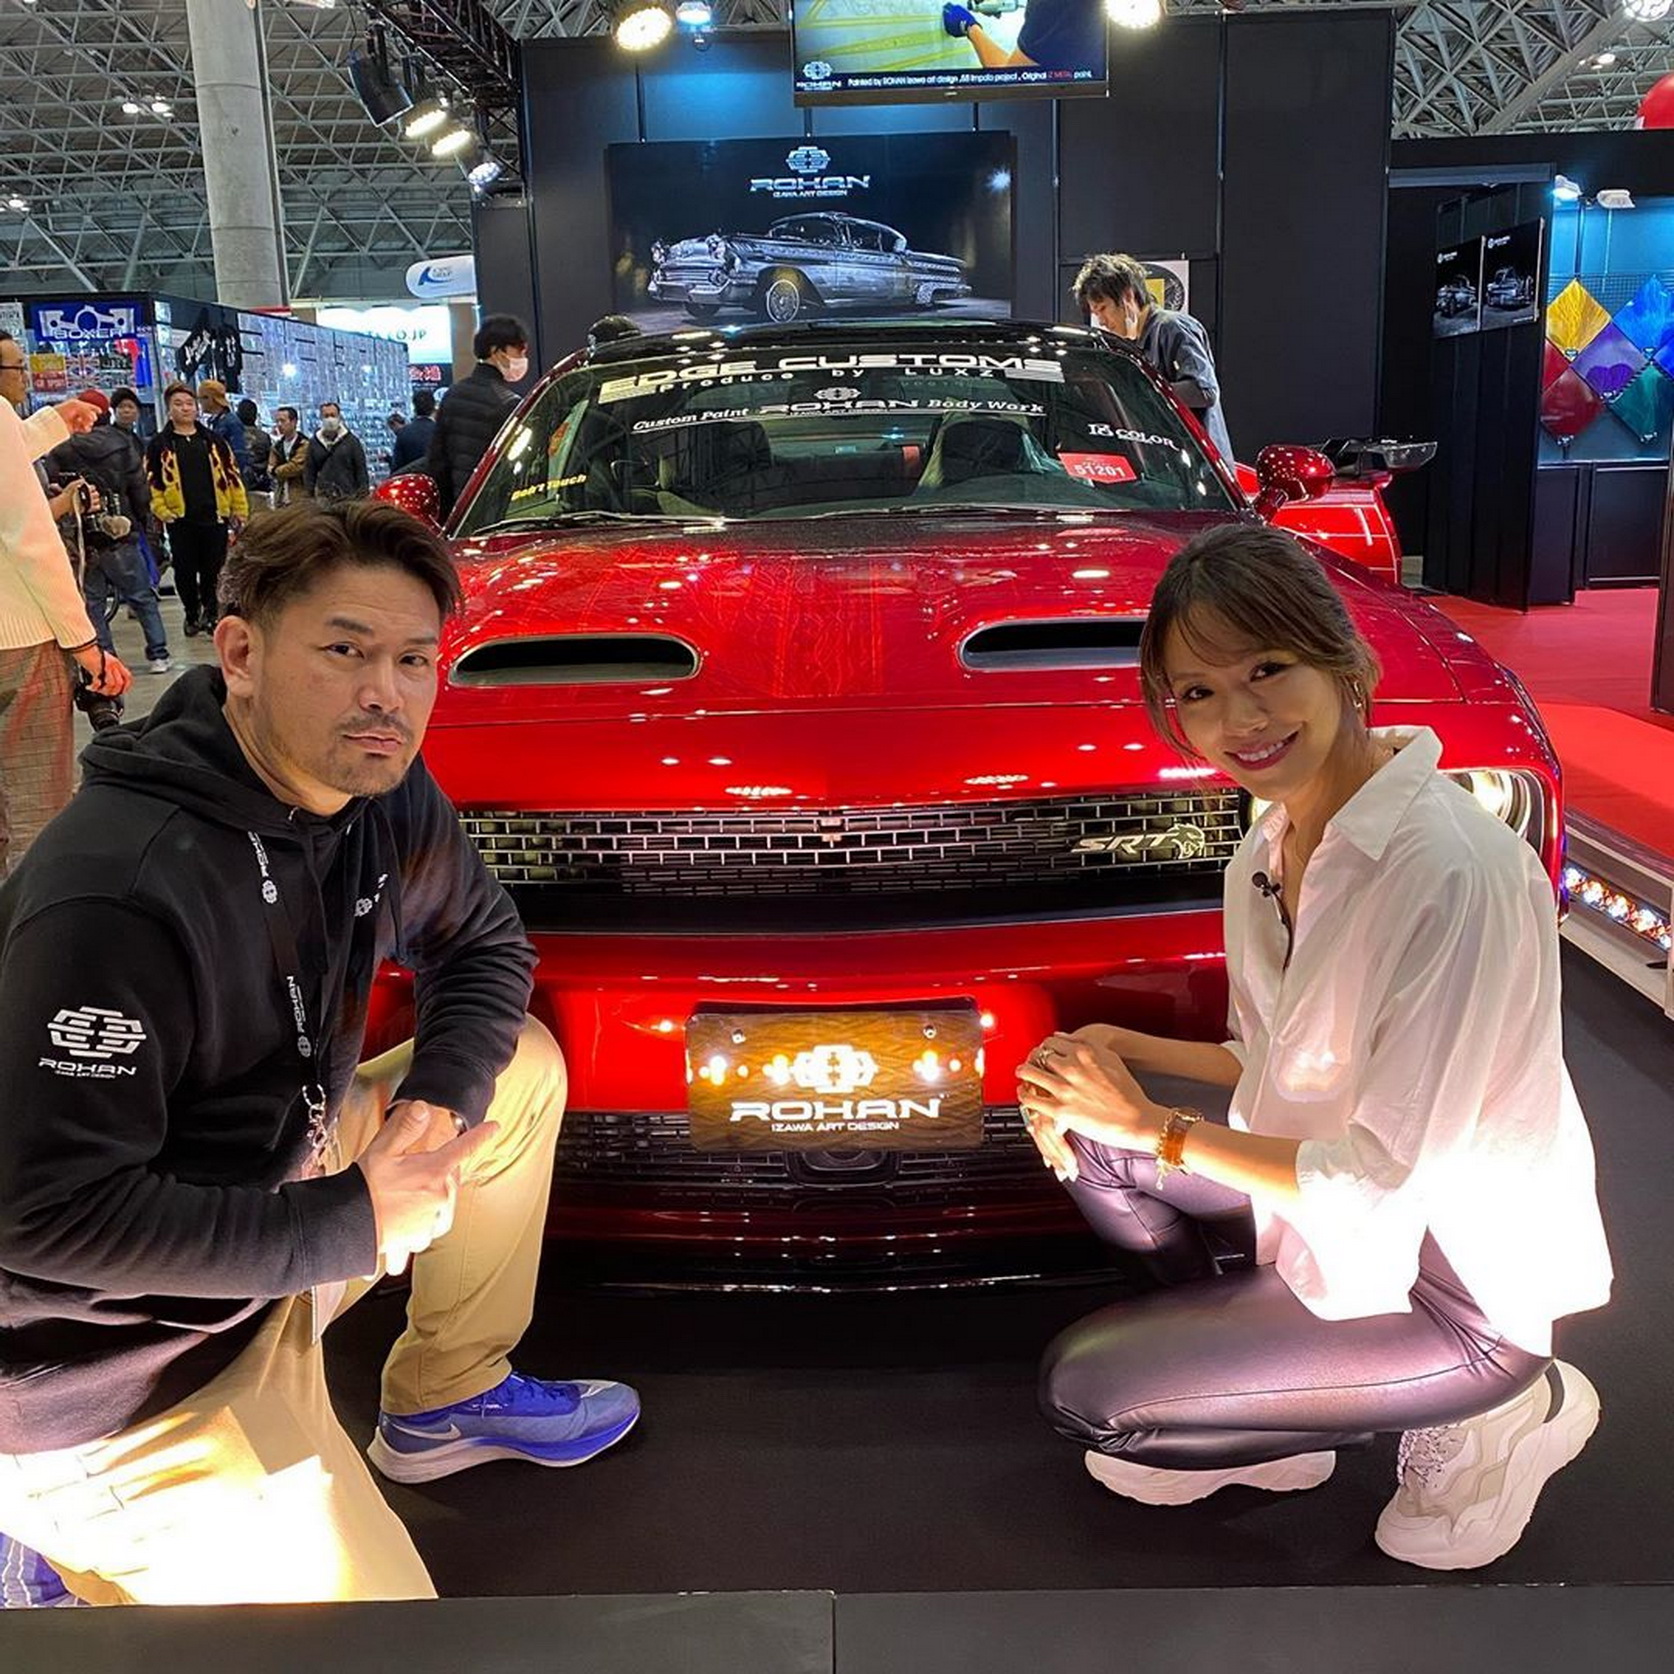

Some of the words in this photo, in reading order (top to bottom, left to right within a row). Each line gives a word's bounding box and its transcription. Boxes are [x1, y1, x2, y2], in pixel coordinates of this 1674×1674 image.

[796, 80, 842, 88] ROHAN
[749, 175, 871, 192] ROHAN
[53, 328, 123, 340] BOXER
[599, 360, 757, 400] EDGE
[777, 354, 1063, 374] CUSTOMS
[657, 371, 794, 394] produce
[831, 368, 864, 378] by
[904, 367, 994, 378] LUXZ
[758, 399, 919, 415] ROHAN
[926, 399, 983, 411] Body
[987, 400, 1044, 413] Work
[632, 415, 697, 431] Custom
[700, 408, 749, 421] Paint
[1073, 463, 1127, 478] 51201
[547, 473, 587, 491] Touch
[1070, 832, 1180, 855] SRT
[38, 1057, 137, 1076] ROHAN
[729, 1098, 942, 1122] ROHAN
[771, 1122, 814, 1132] IZAWA
[816, 1122, 846, 1132] ART
[847, 1121, 900, 1131] DESIGN
